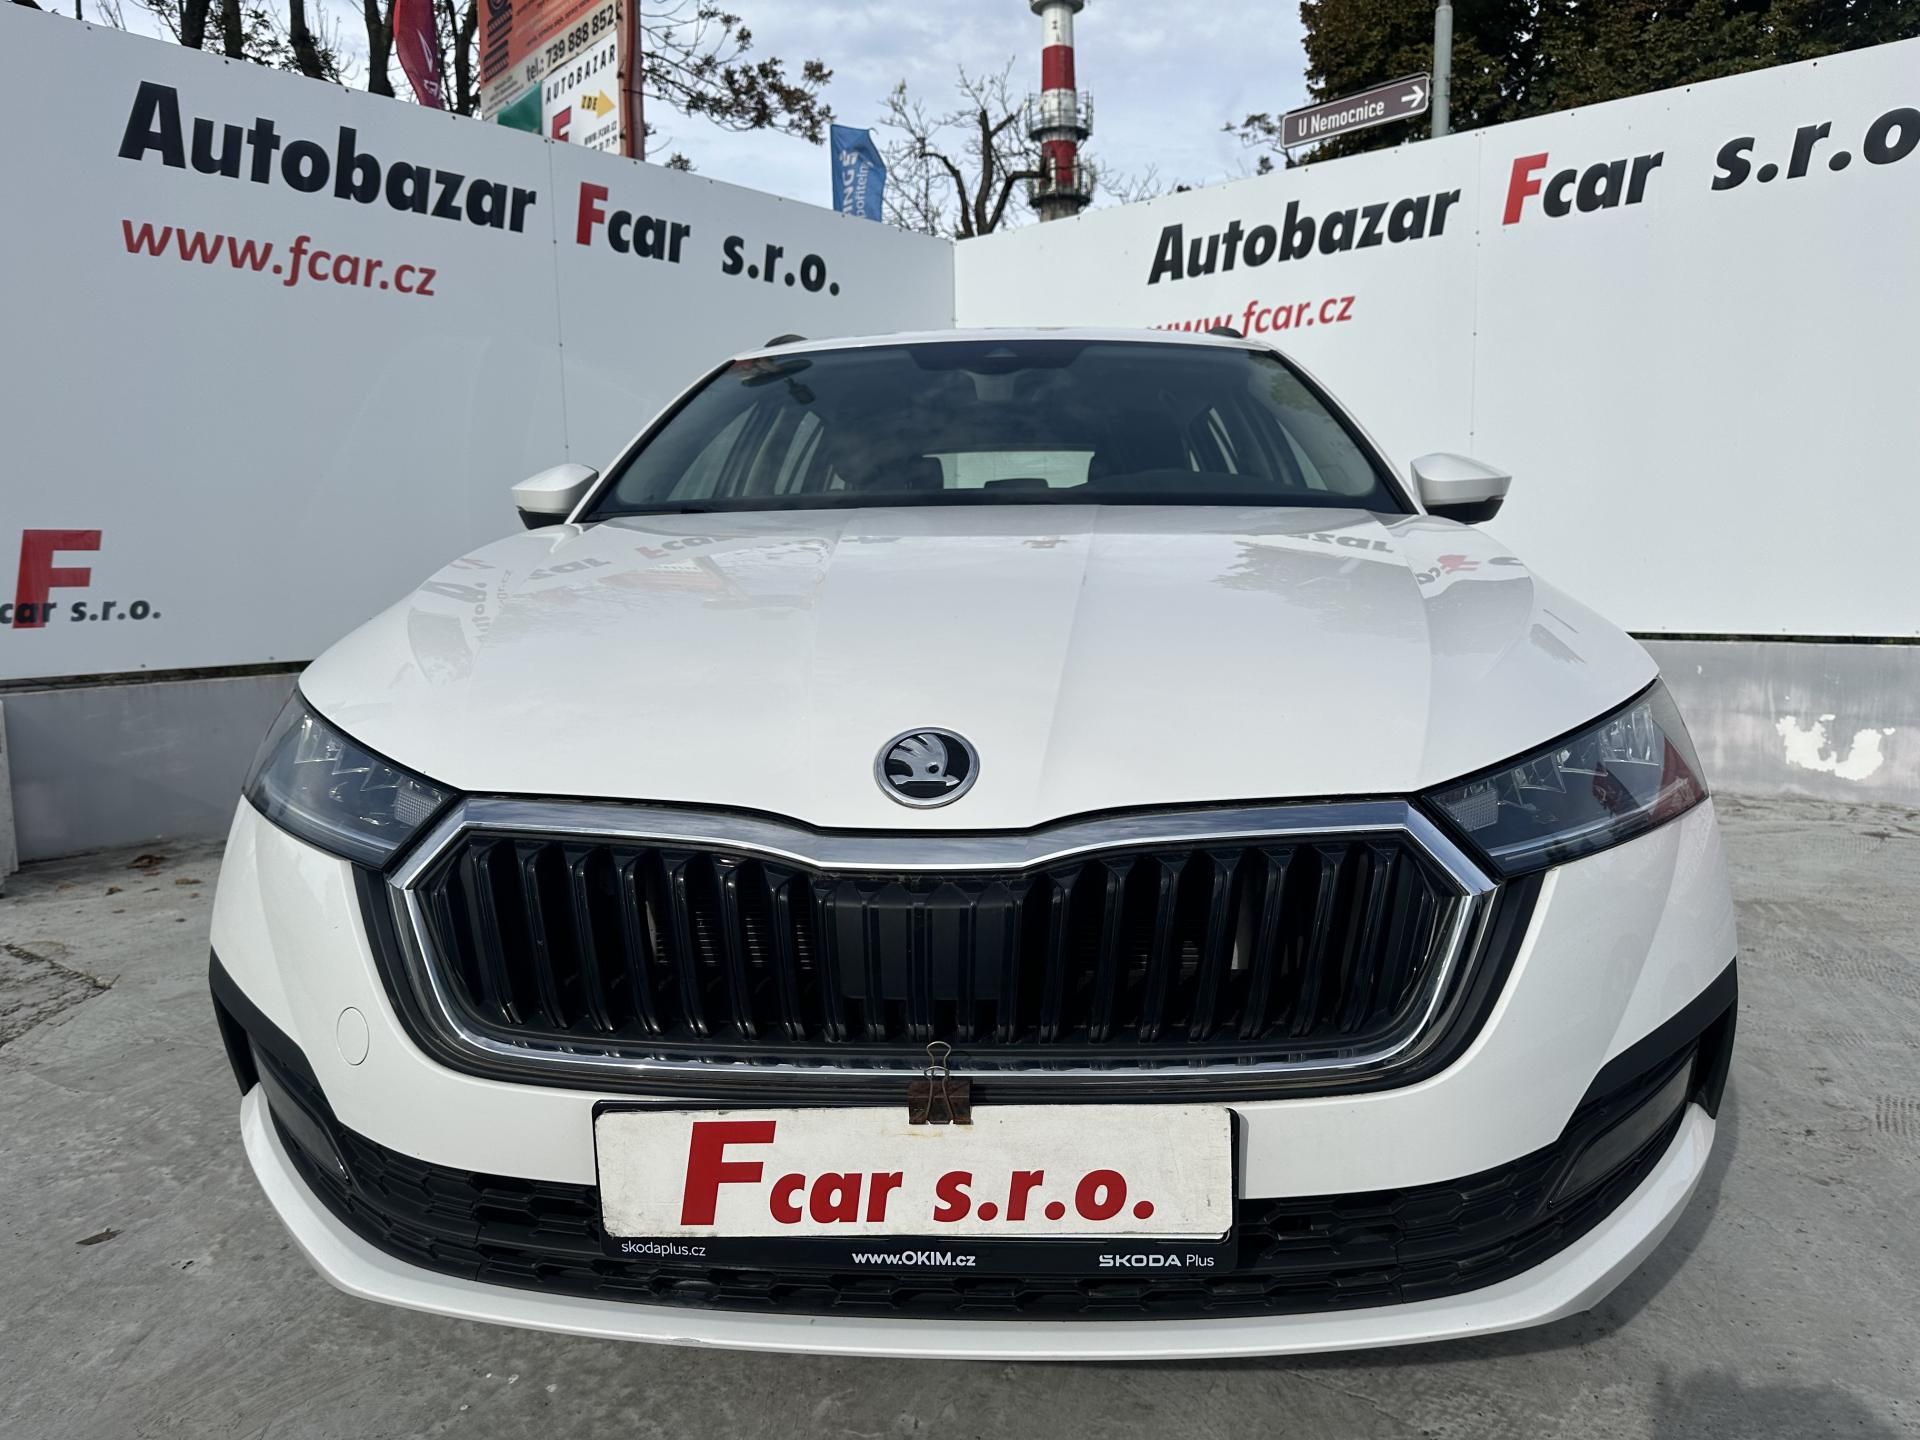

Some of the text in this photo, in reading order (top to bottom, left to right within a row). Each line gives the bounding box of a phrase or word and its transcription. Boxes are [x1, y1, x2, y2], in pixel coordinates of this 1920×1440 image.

[545, 40, 566, 68] 739
[568, 23, 590, 53] 888
[592, 4, 614, 36] 852
[545, 44, 616, 104] AUTOBAZAR
[581, 95, 598, 111] ZDE
[1298, 100, 1385, 137] U Nemocnice
[119, 80, 537, 233] Autobazar
[578, 182, 690, 263] Fcar
[723, 236, 840, 296] s.r.o.
[1148, 187, 1460, 284] Autobazar
[1504, 152, 1663, 225] Fcar
[121, 219, 438, 297] www.fcar.cz
[70, 600, 161, 622] s.r.o.
[681, 1120, 1155, 1226] Fcar s.r.o.
[620, 1241, 707, 1257] skodaplus.cz
[851, 1250, 977, 1268] www.OKIM.cz
[1186, 1254, 1215, 1268] Plus
